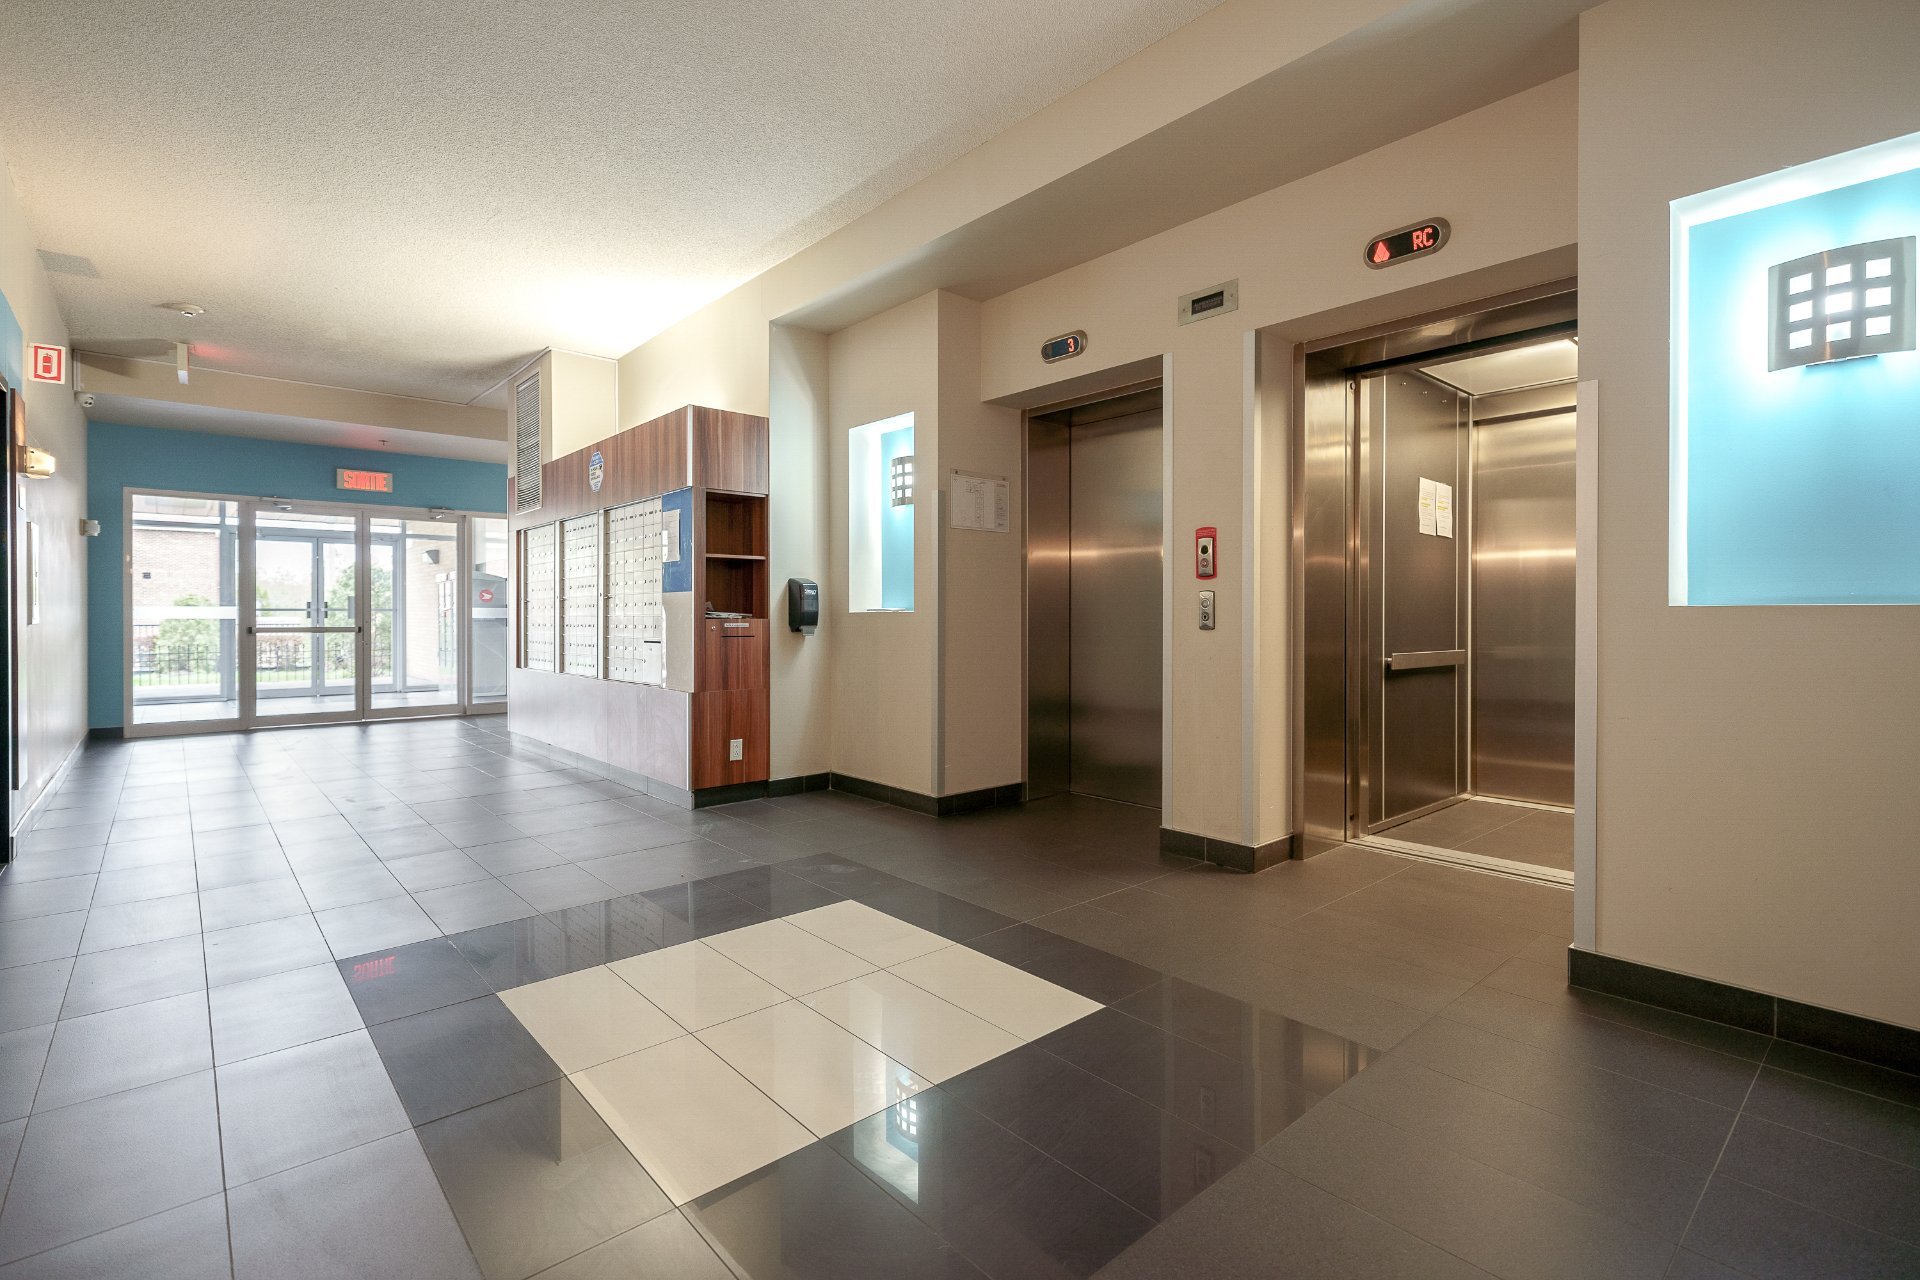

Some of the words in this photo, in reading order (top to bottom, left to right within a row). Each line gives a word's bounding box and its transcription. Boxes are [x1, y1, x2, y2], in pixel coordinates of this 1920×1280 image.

[1412, 227, 1433, 251] RC
[1067, 338, 1075, 352] 3
[343, 470, 388, 492] SORTIE
